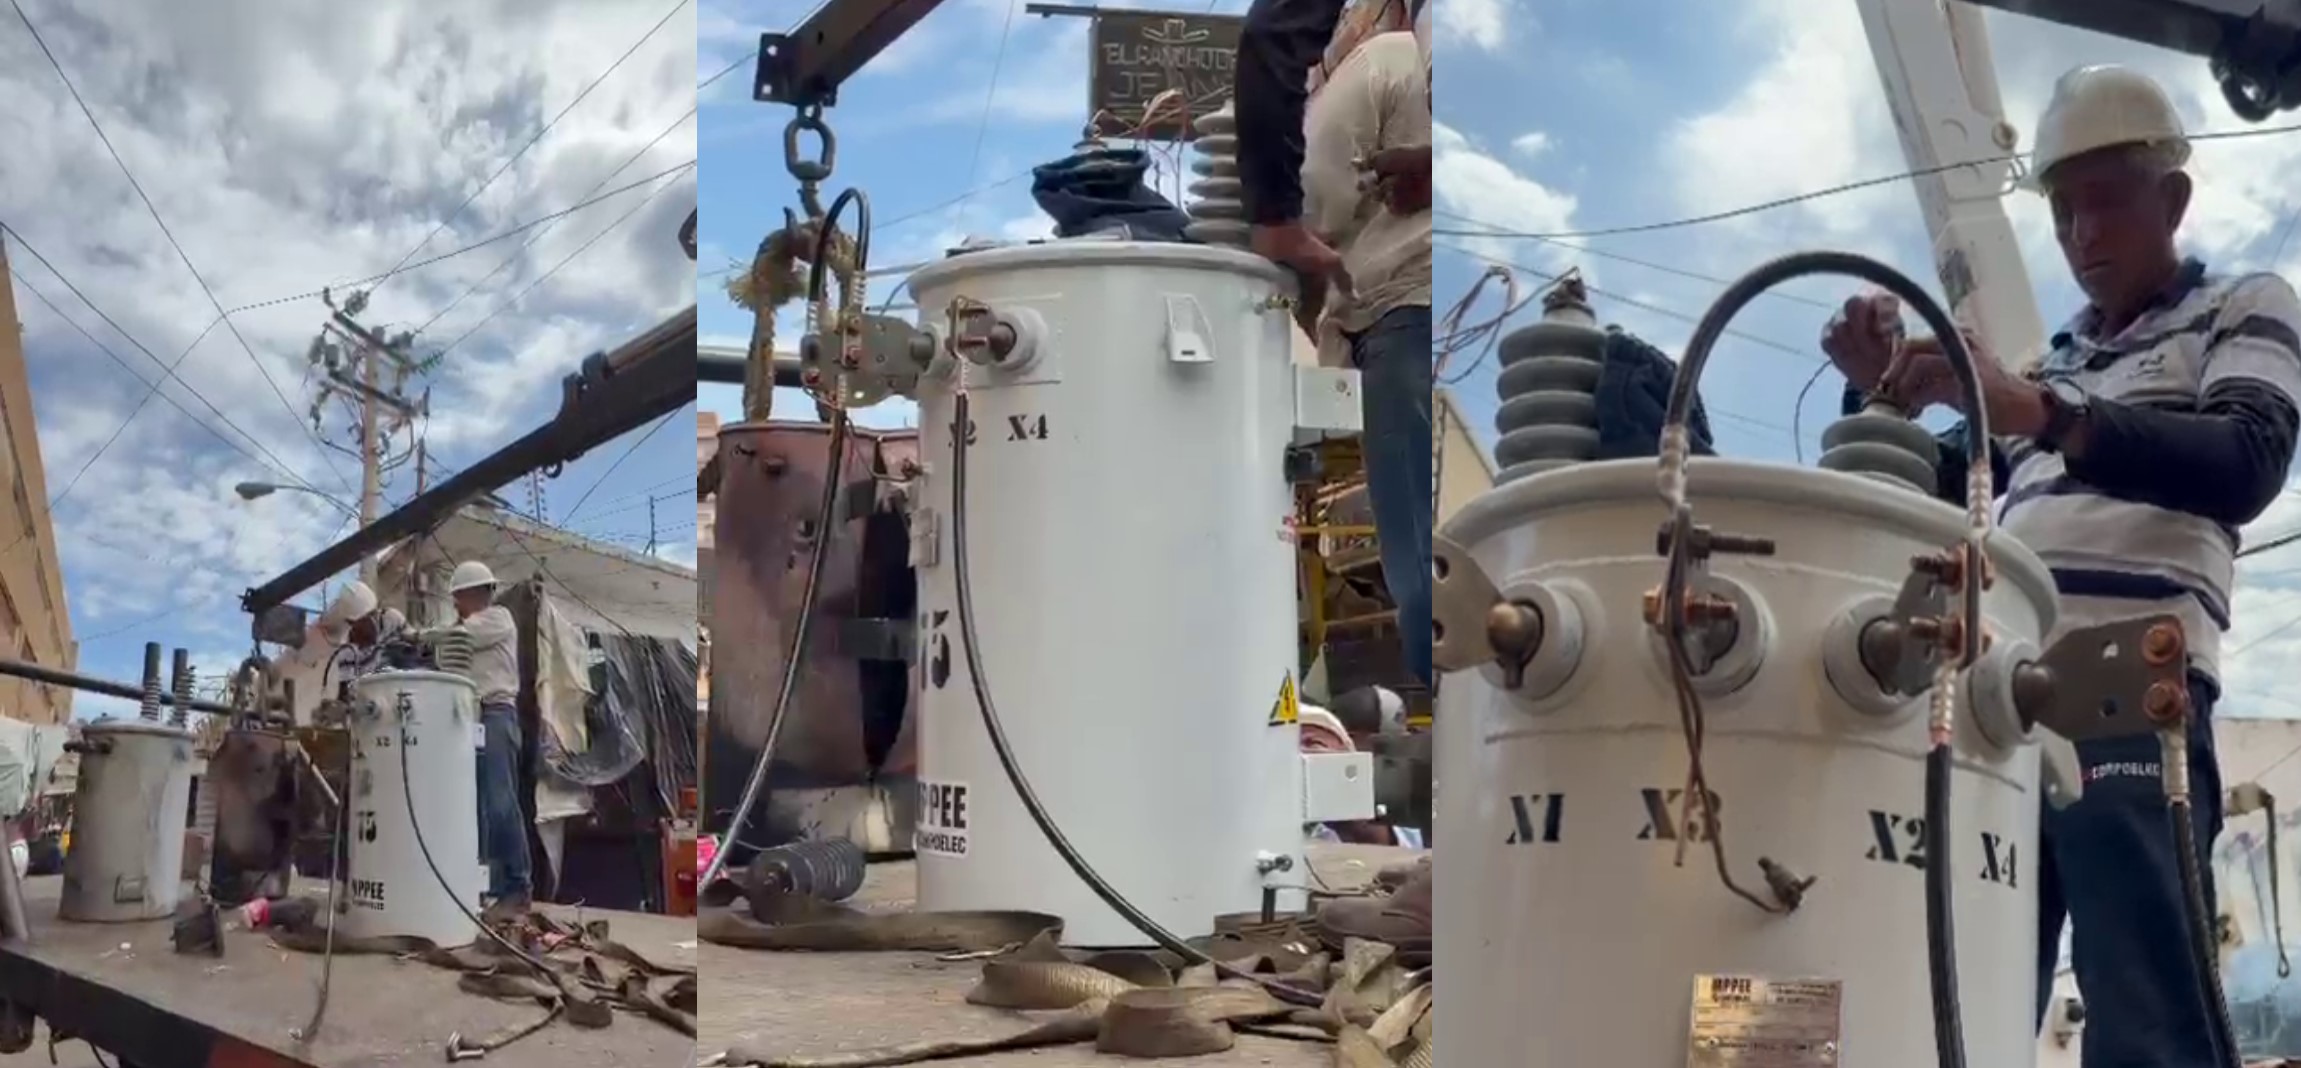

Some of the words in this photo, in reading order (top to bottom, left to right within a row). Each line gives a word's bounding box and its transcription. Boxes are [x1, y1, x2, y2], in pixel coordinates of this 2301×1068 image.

[1007, 413, 1050, 442] X4
[1505, 793, 1566, 844] X1
[1864, 809, 1928, 871] X2
[1978, 830, 2018, 889] X4
